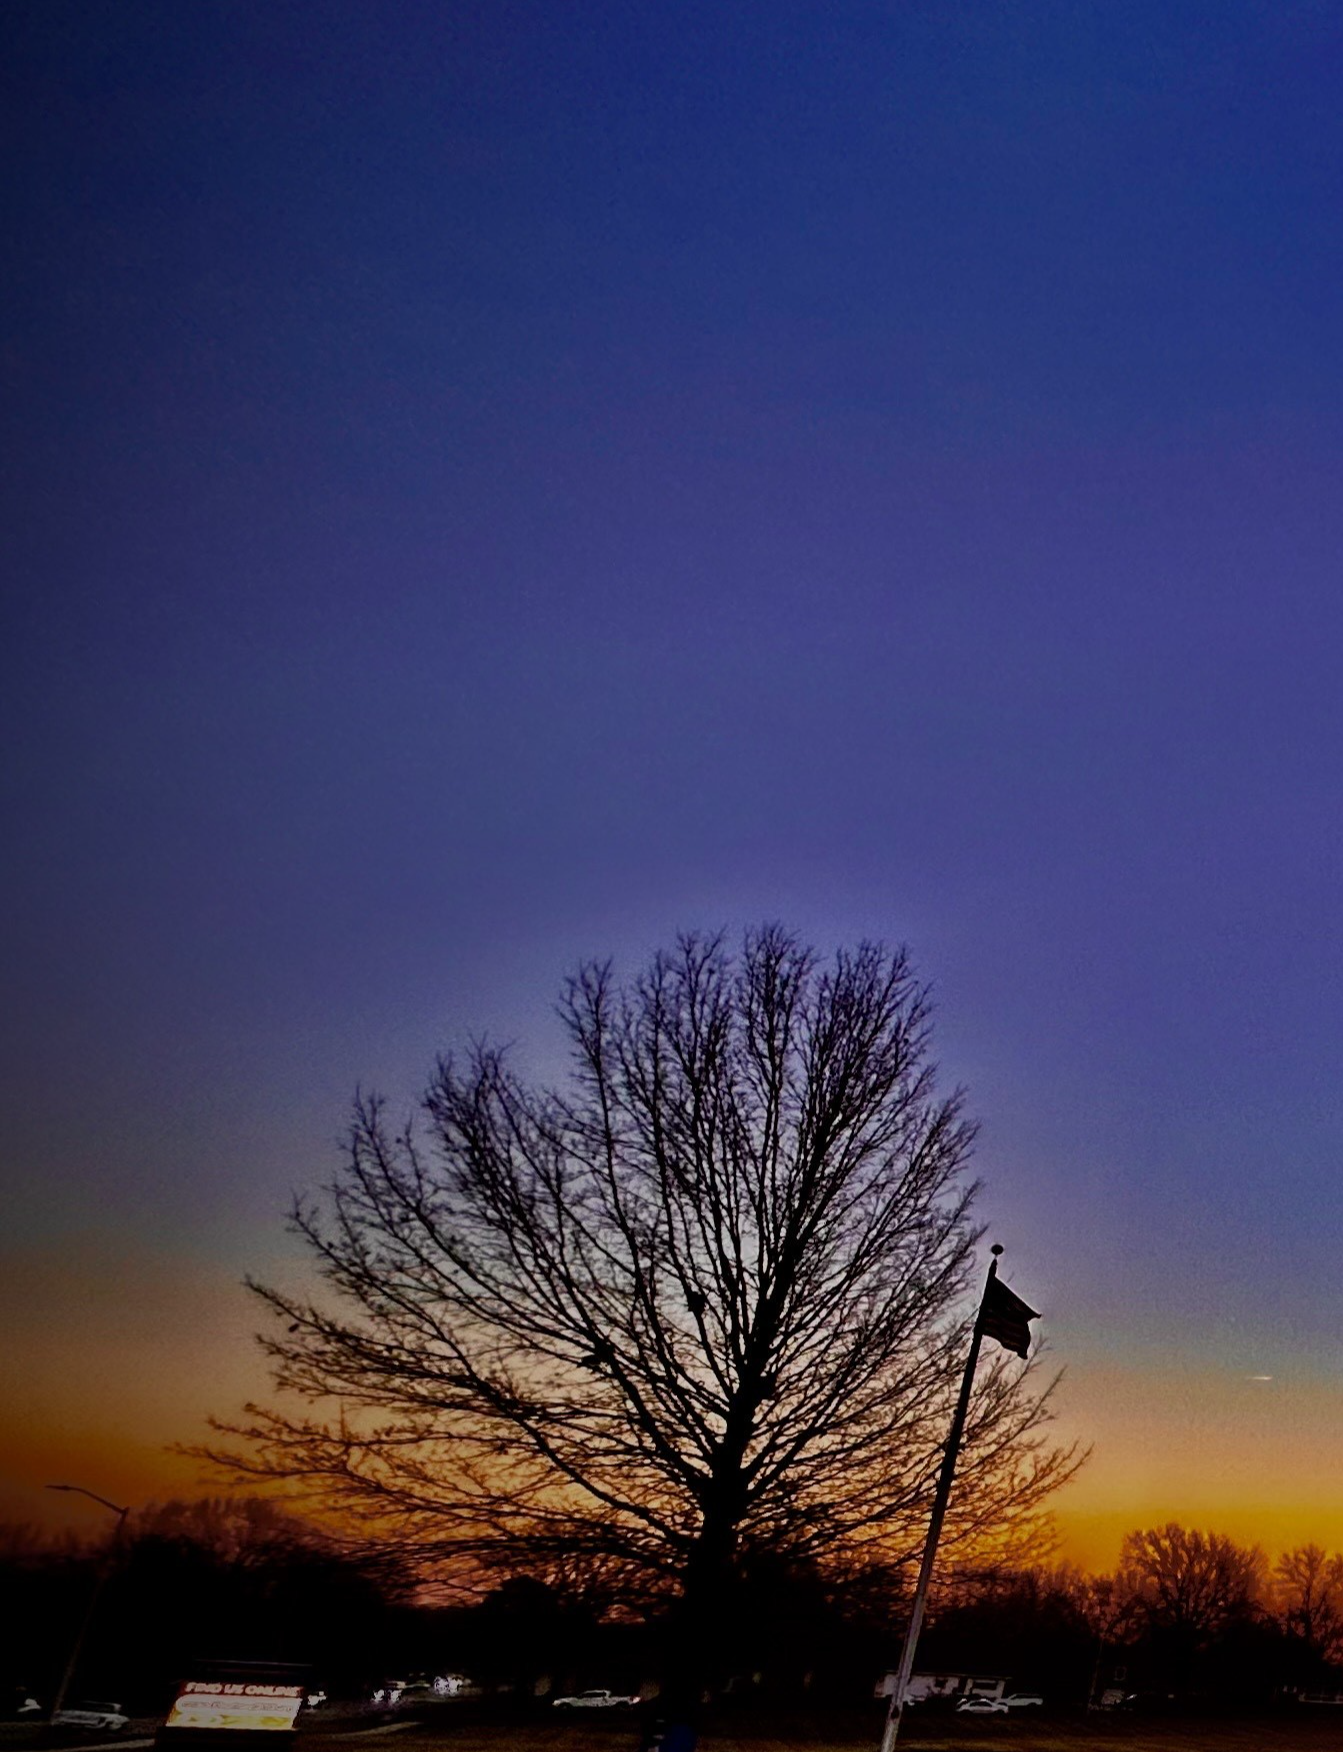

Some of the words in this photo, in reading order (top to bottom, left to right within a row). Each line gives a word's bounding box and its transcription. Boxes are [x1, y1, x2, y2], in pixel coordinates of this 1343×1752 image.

[185, 1682, 223, 1694] FIND
[224, 1683, 245, 1695] US
[244, 1684, 303, 1697] ONLINE
